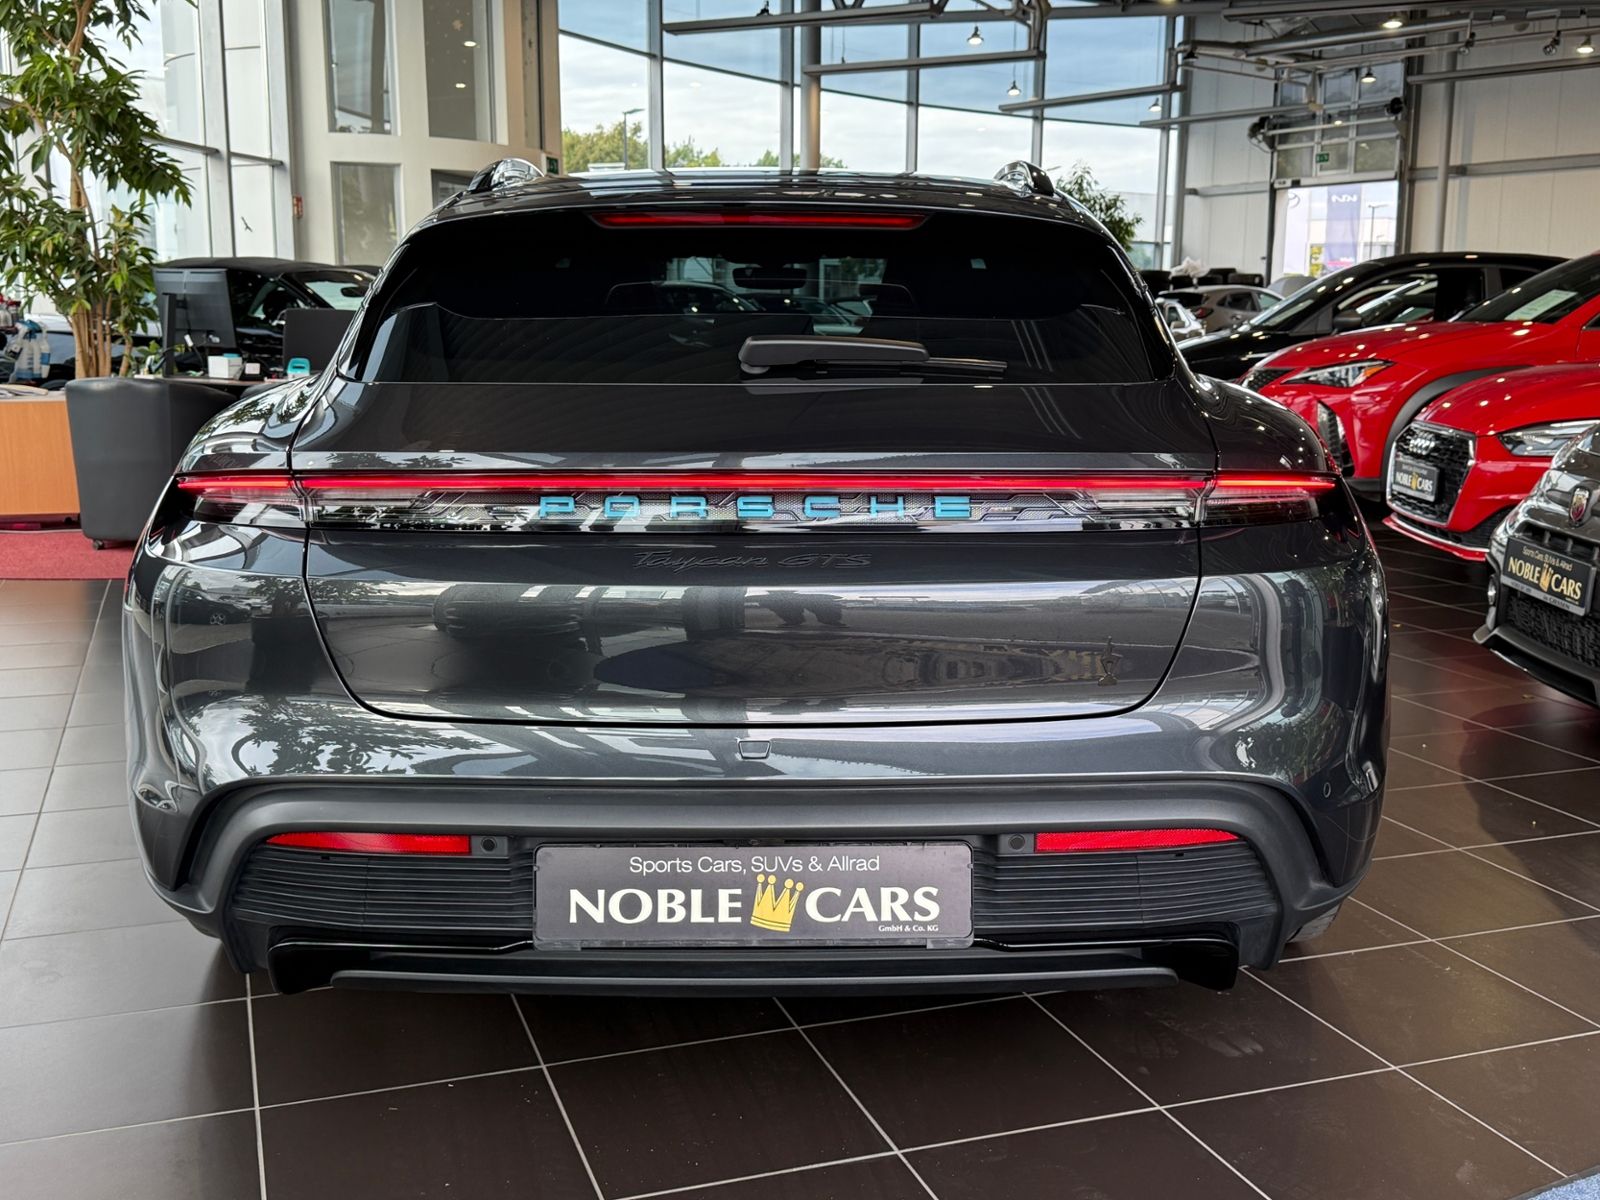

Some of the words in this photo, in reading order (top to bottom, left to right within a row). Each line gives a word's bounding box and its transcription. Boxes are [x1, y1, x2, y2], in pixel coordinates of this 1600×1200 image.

[1417, 477, 1433, 492] CARS
[539, 495, 971, 520] PORSCHE
[633, 550, 769, 573] Taycan
[778, 552, 872, 568] GTS
[1508, 556, 1541, 584] NOBLE
[1551, 574, 1582, 600] CARS
[630, 856, 692, 876] Sports
[698, 856, 746, 875] Cars,
[751, 856, 803, 872] SUVs
[809, 856, 823, 872] &
[827, 855, 880, 872] Allrad
[569, 888, 742, 924] NOBLE
[805, 887, 940, 923] CARS
